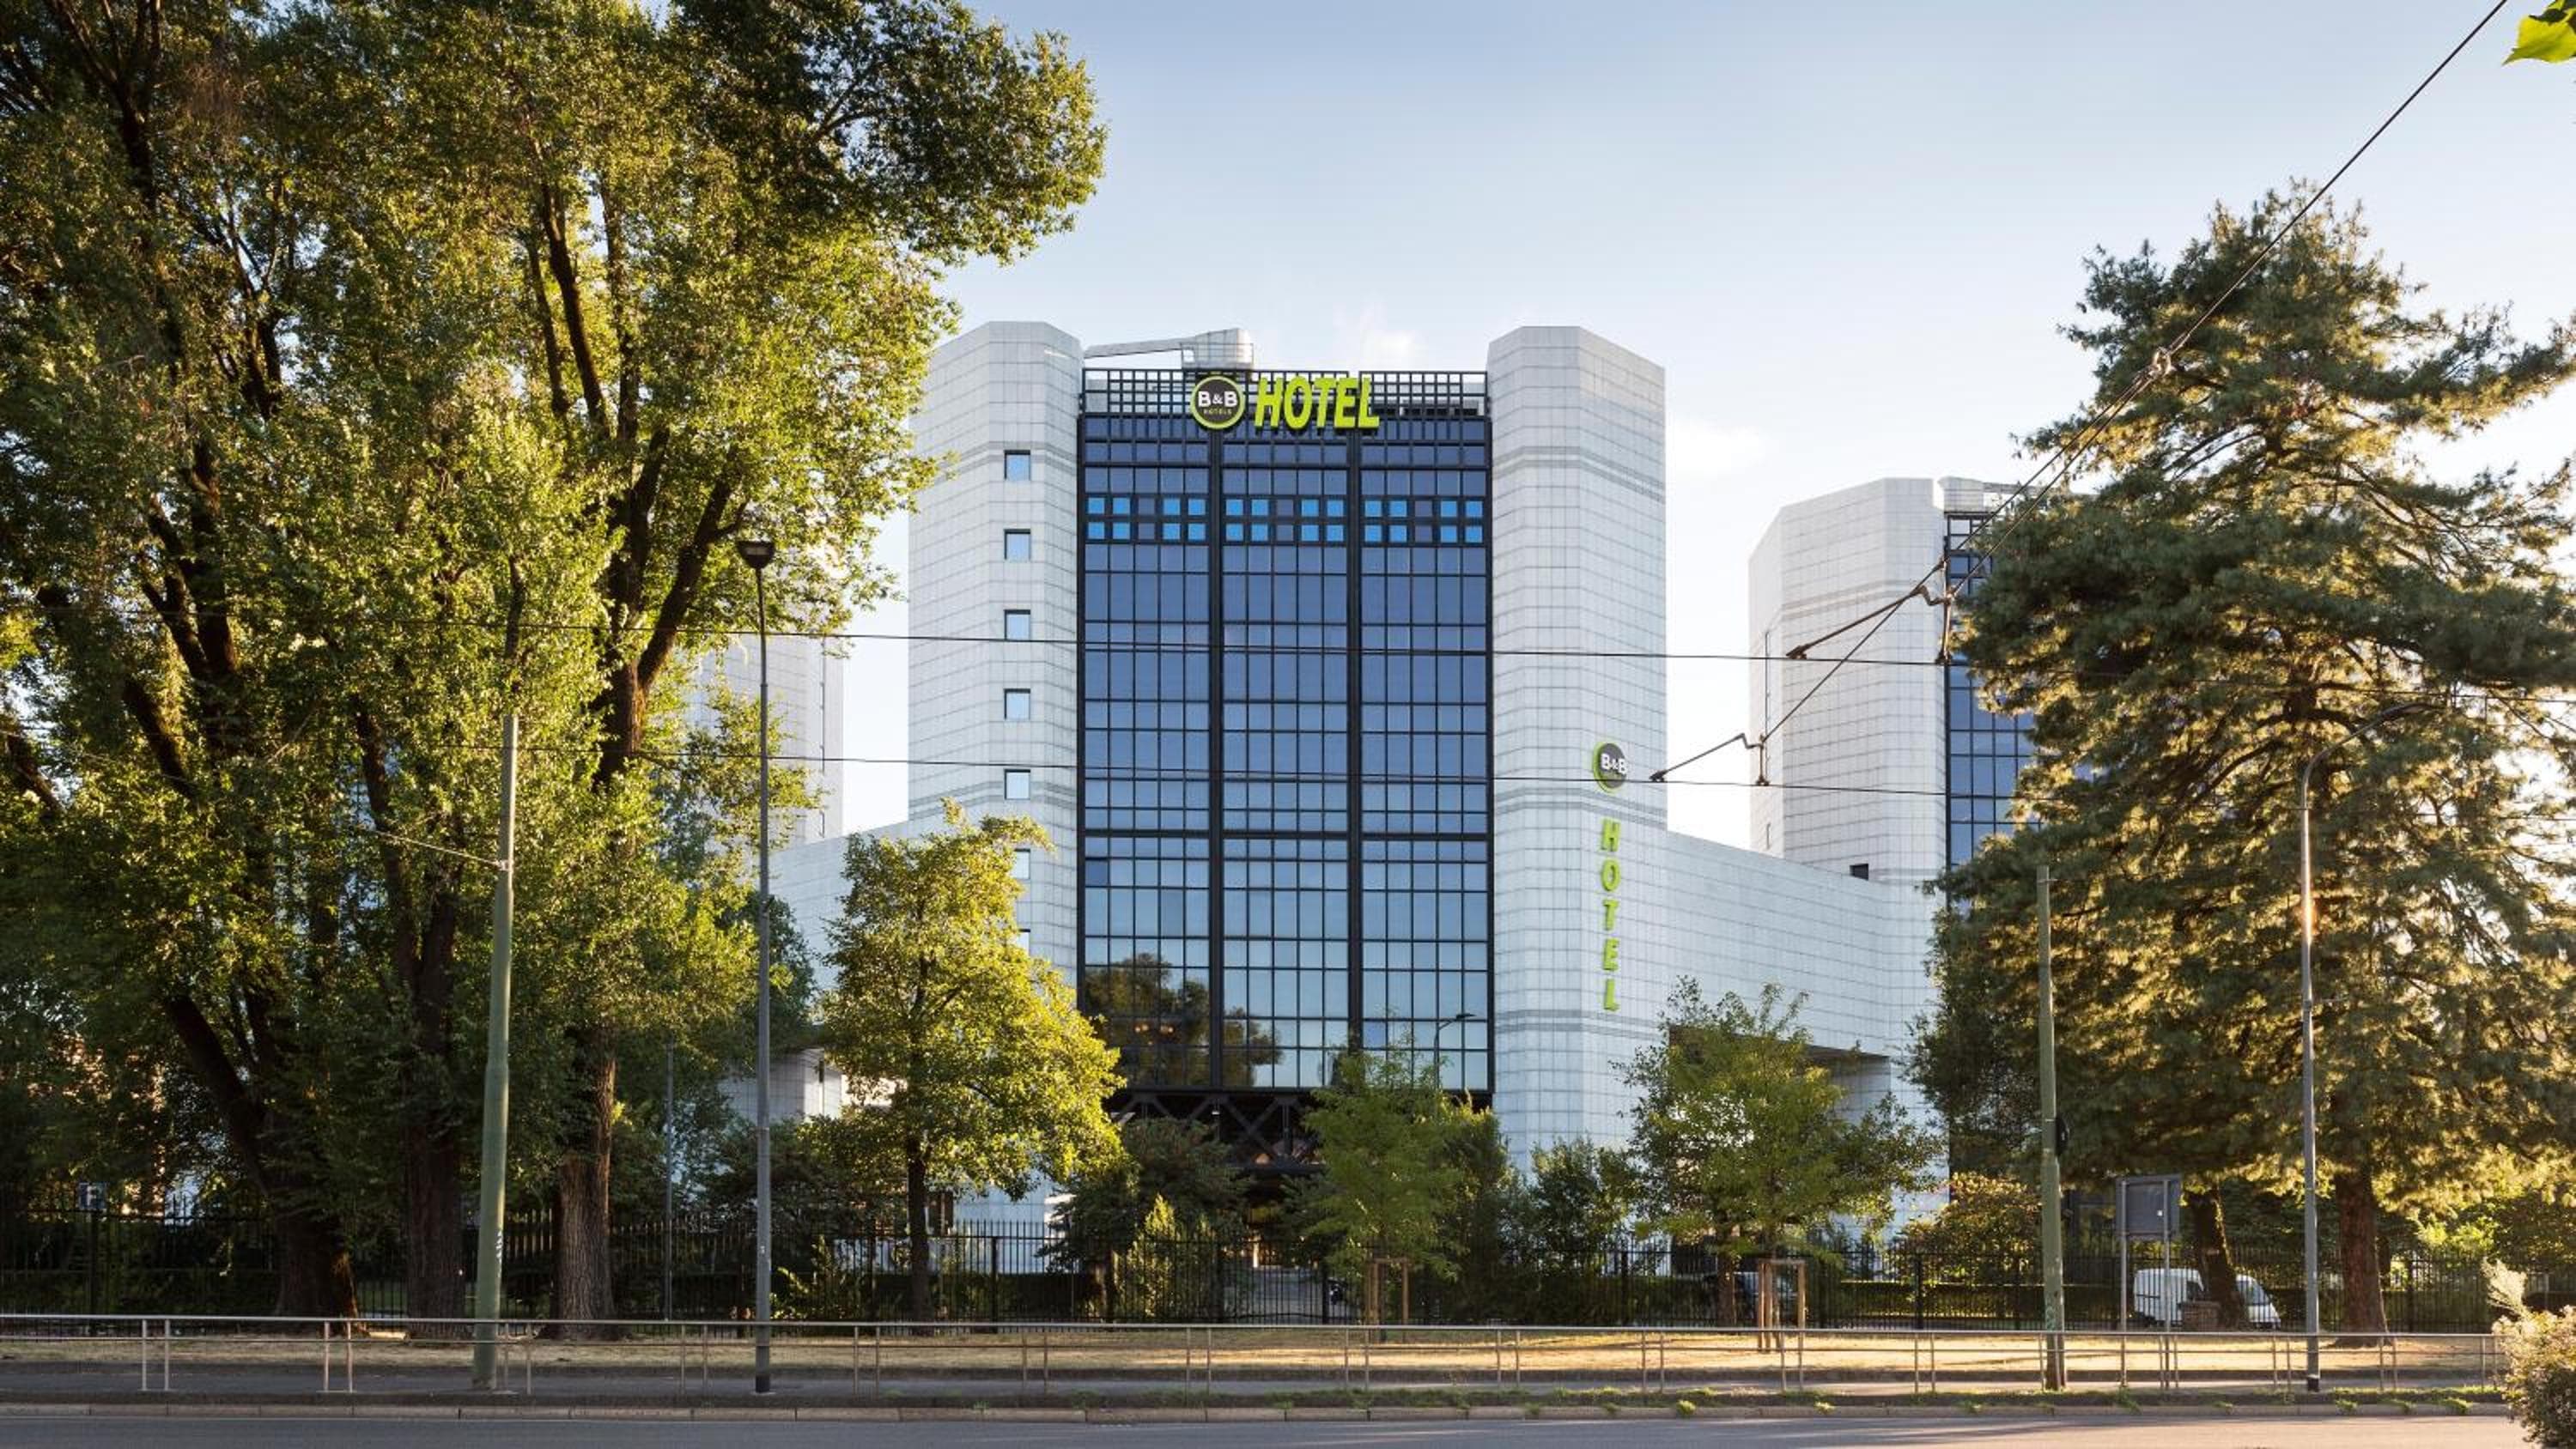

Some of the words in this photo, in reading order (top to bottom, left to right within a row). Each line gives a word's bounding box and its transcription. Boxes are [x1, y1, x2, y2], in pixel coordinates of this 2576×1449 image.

[1198, 391, 1238, 408] B&B
[1255, 376, 1380, 429] HOTEL
[1601, 753, 1627, 774] B&B
[1601, 818, 1620, 1011] HOTEL
